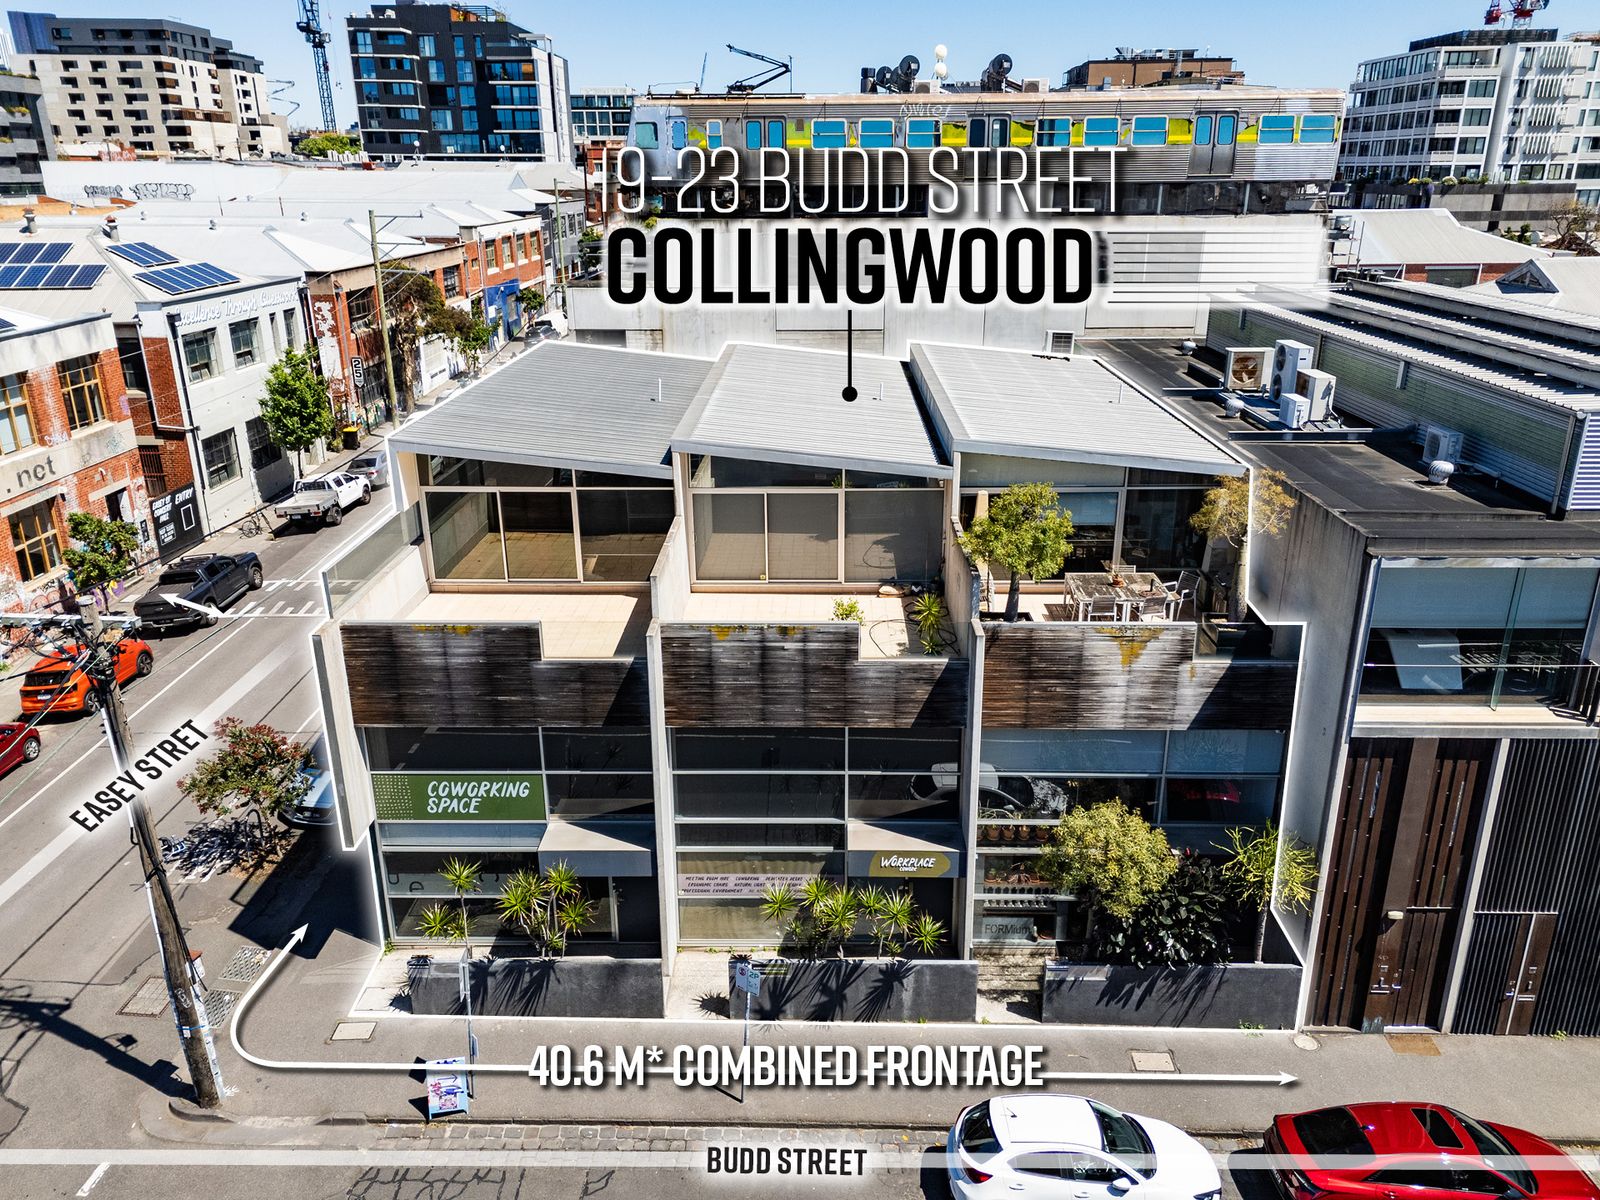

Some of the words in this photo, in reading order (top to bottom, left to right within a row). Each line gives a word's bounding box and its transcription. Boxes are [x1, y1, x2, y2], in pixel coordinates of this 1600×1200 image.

[175, 487, 194, 504] ENTRY
[427, 781, 530, 797] COWORKING
[427, 798, 482, 813] SPACE
[880, 855, 936, 868] WORKPLACE
